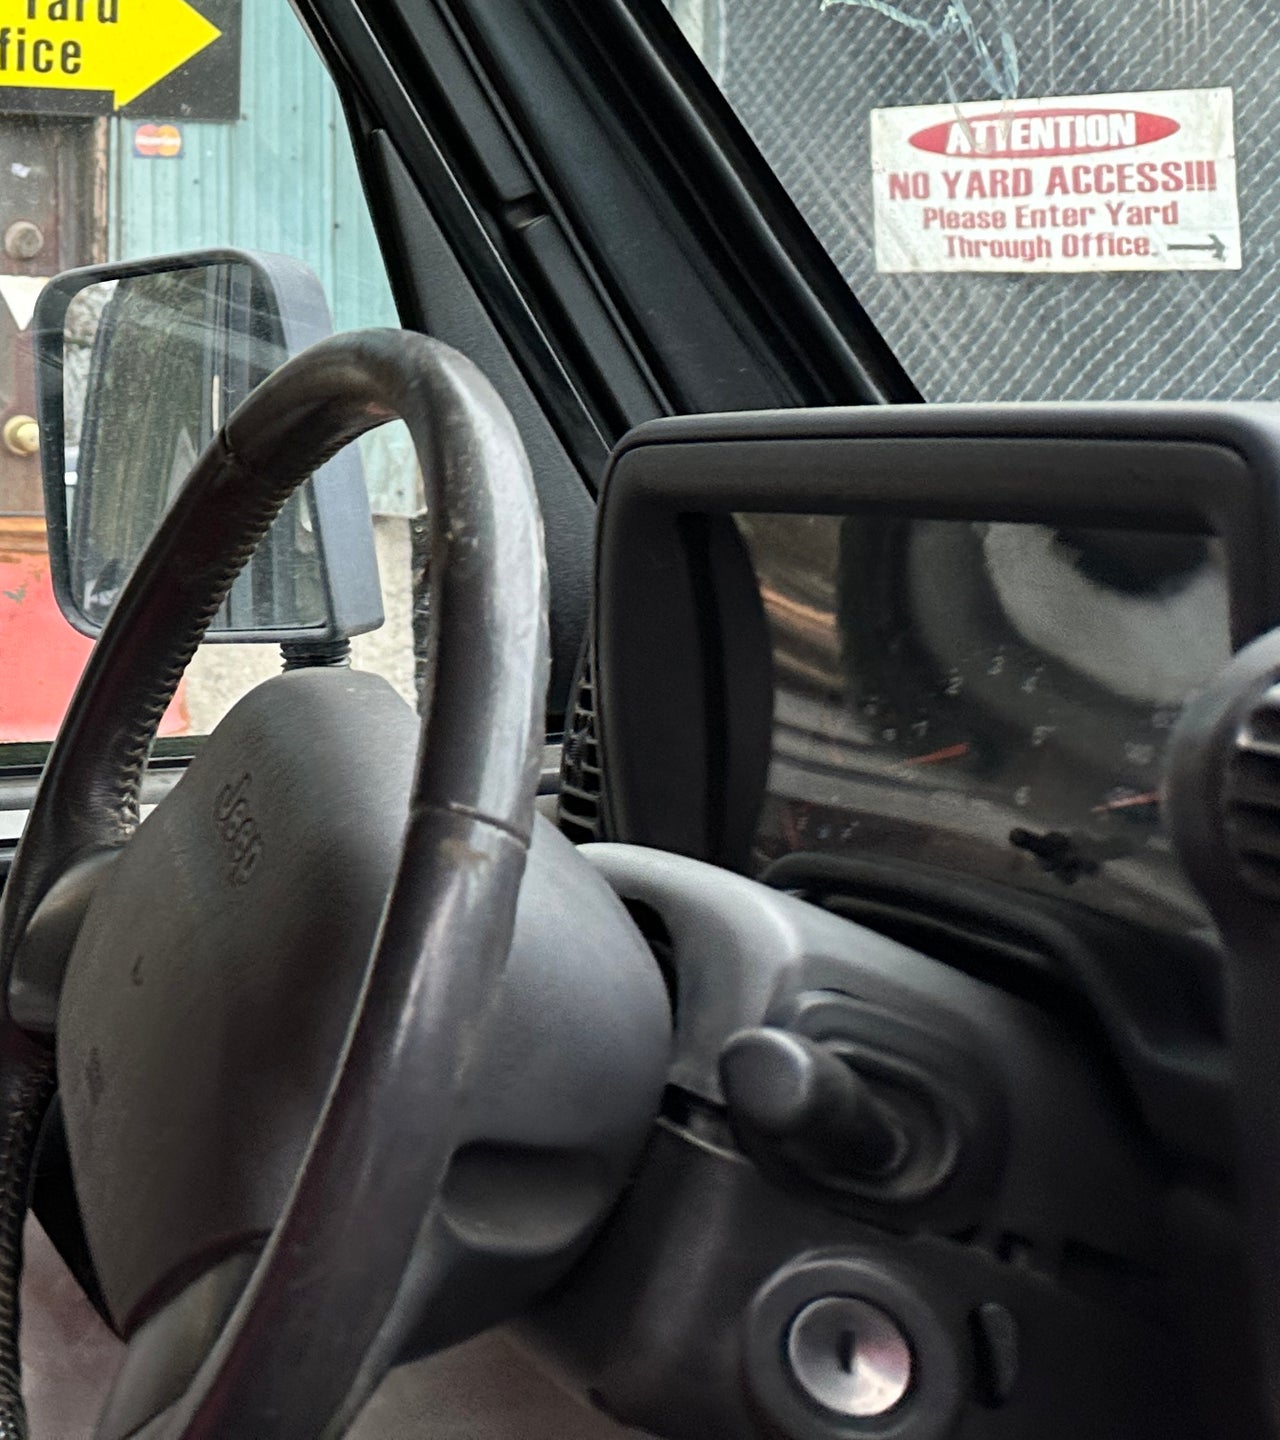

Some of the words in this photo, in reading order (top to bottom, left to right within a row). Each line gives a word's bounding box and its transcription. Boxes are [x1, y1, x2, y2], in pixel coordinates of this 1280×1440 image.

[945, 112, 1138, 155] ATTENTION
[888, 170, 931, 201] NO
[940, 167, 1034, 200] YARD
[1044, 160, 1218, 197] ACCESS!!!
[921, 205, 1008, 231] Please
[1014, 203, 1096, 230] Enter
[1104, 199, 1180, 227] Yard
[944, 233, 1053, 263] Through
